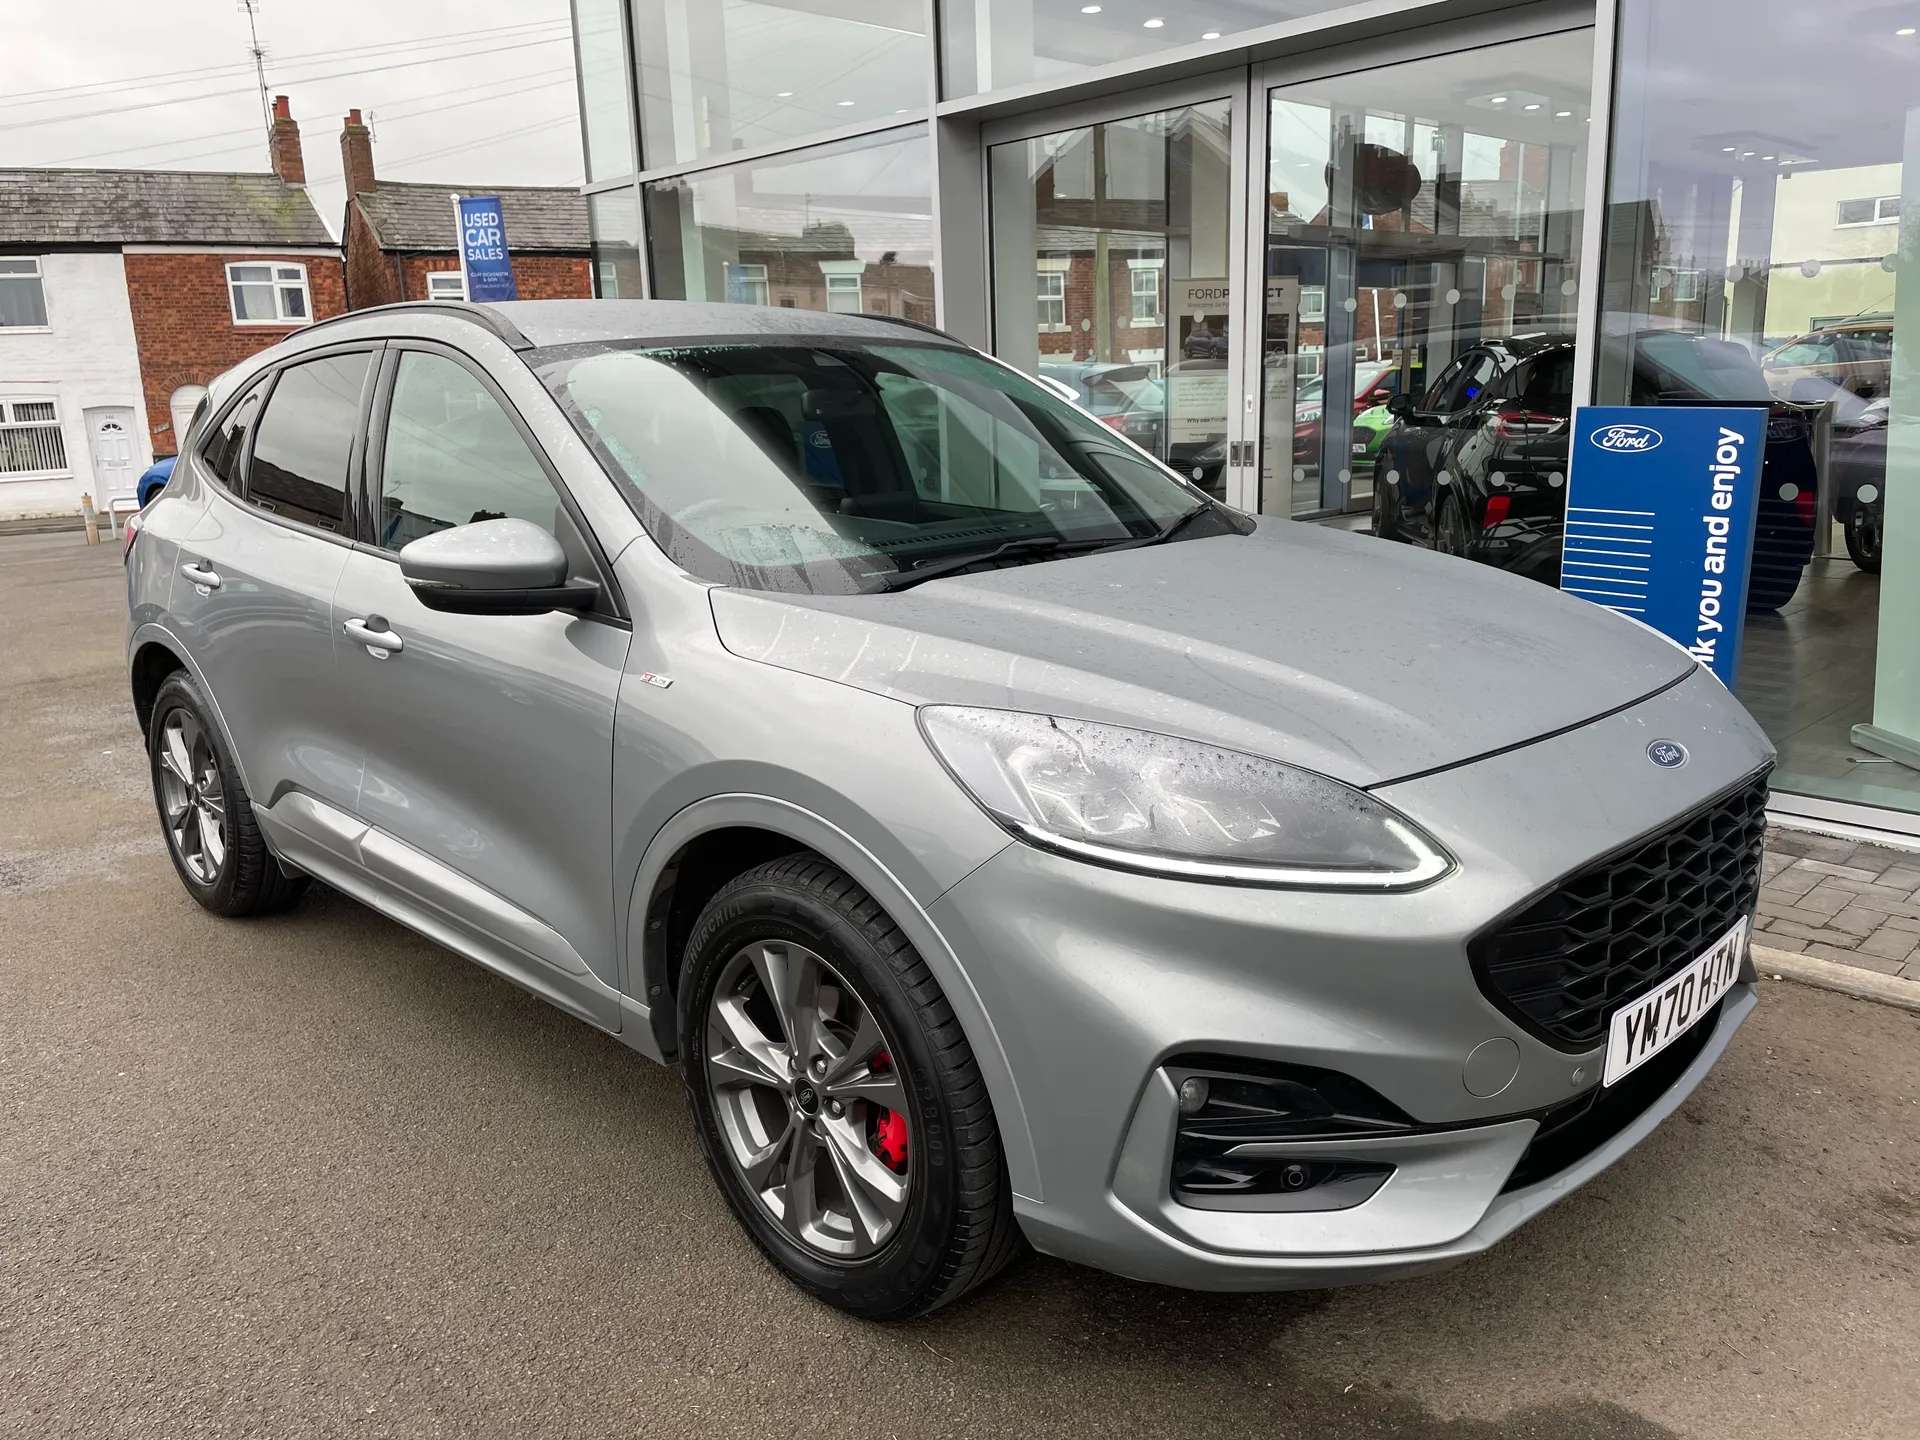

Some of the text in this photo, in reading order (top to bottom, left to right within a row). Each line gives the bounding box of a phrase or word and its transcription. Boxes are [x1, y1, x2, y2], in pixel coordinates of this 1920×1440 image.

[464, 212, 498, 227] USED
[465, 228, 500, 246] CAR
[467, 248, 503, 260] SALES
[1708, 426, 1745, 510] enjoy
[1703, 515, 1730, 575] and
[1697, 579, 1723, 632] you
[1655, 745, 1680, 763] Ford
[686, 901, 744, 975] CHURCHILL
[1625, 931, 1740, 1066] YM70 HTN
